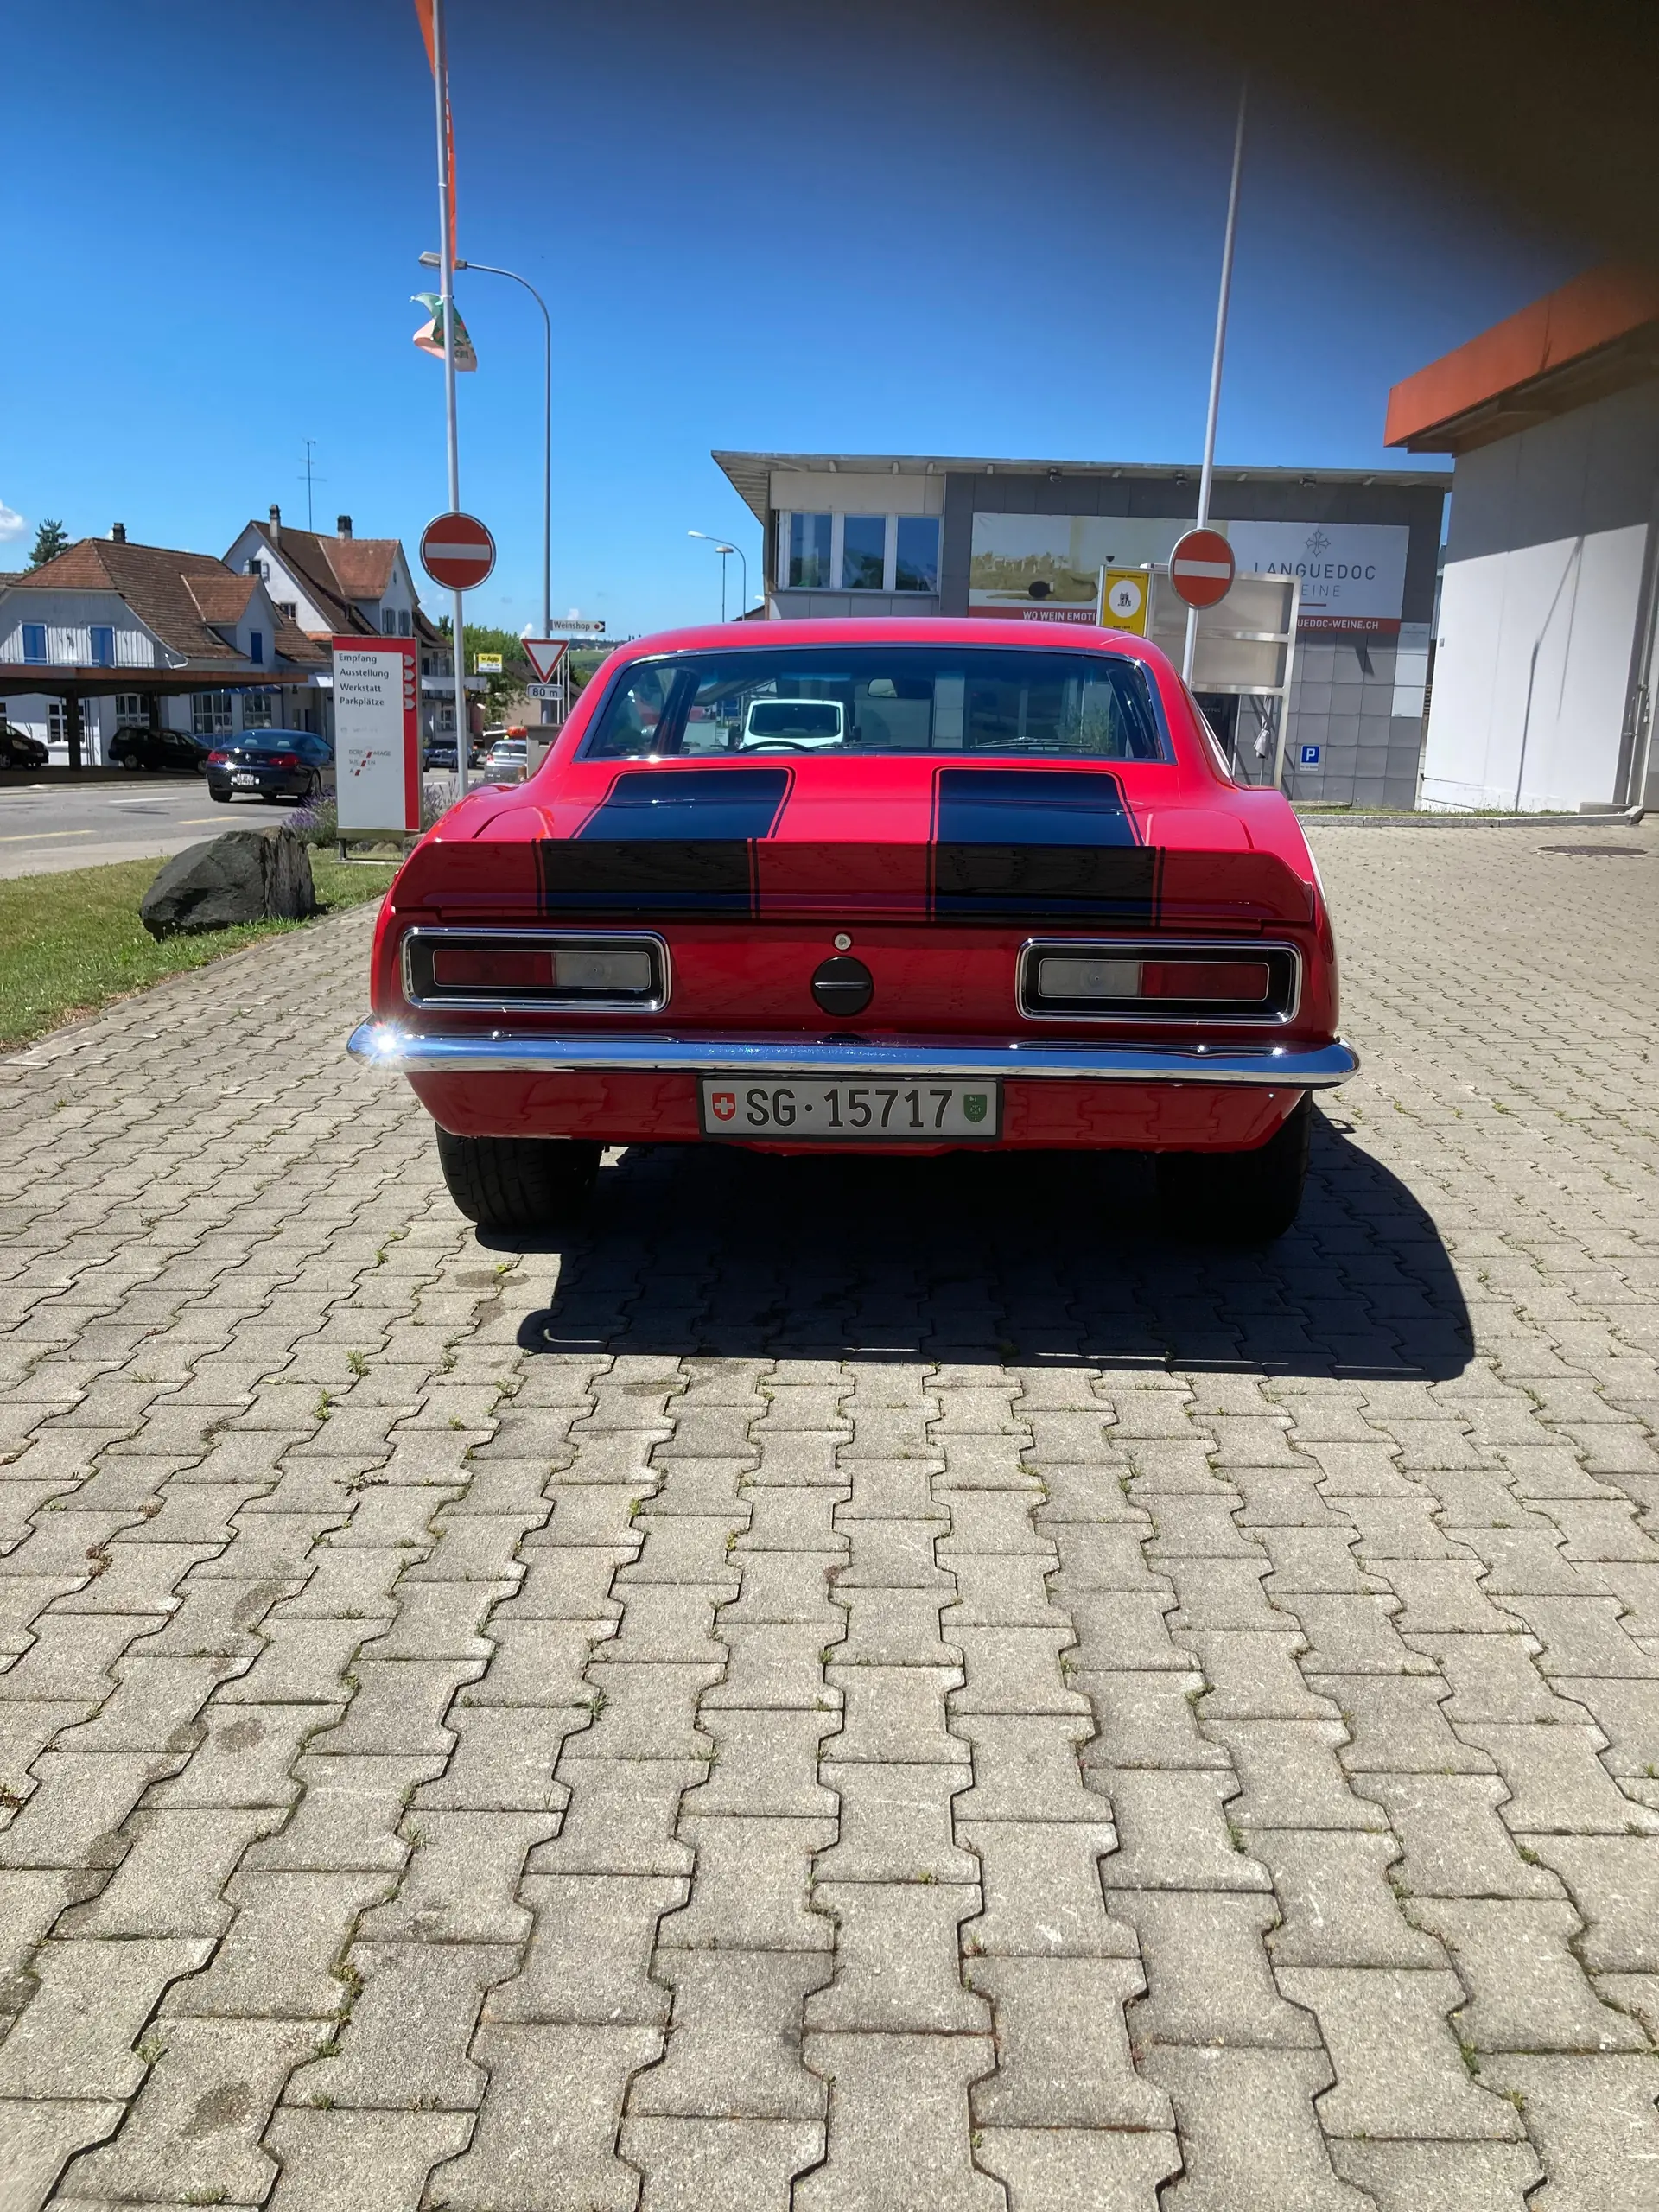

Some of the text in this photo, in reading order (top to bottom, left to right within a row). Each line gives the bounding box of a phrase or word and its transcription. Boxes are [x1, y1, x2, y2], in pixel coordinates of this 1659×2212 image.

[1301, 583, 1340, 598] EINE
[1023, 610, 1098, 622] WO WEIN EMOTI
[553, 620, 590, 632] Weinshop
[1297, 618, 1379, 630] UEDOC-WEINE.CH
[339, 653, 378, 664] Empfang
[340, 668, 390, 680] Ausstellung
[340, 683, 382, 693] Werkstatt
[532, 687, 546, 696] 80
[340, 696, 385, 707] Parkplätze
[1306, 747, 1316, 762] P
